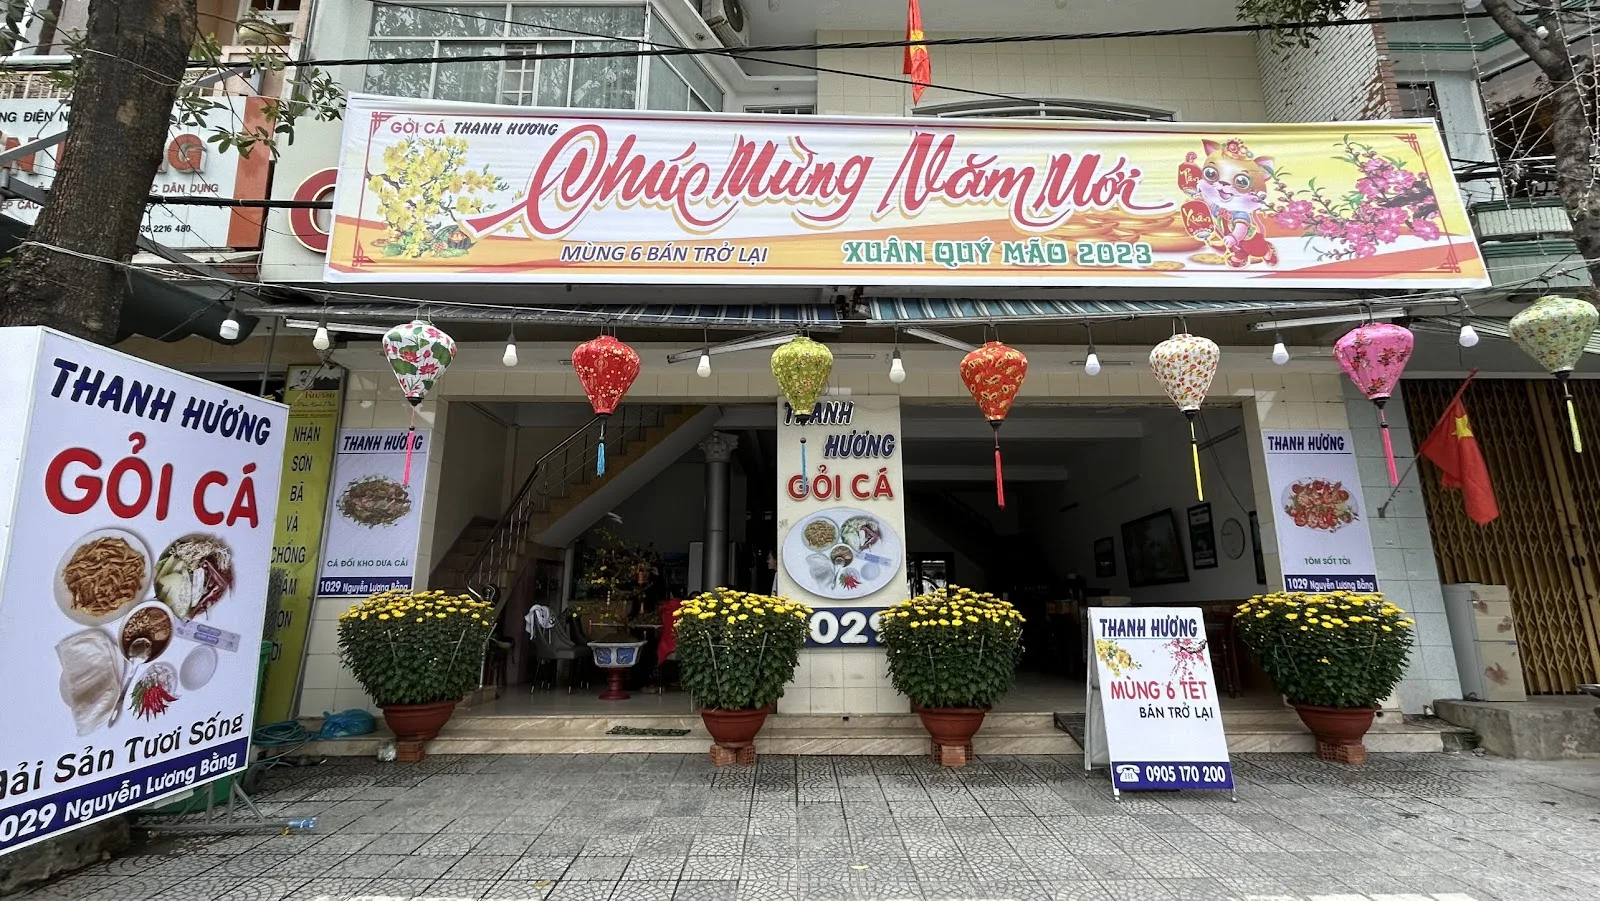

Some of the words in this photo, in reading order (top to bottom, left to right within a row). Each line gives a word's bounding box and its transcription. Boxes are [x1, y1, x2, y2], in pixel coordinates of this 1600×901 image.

[23, 109, 53, 124] ĐIỆN
[390, 118, 419, 134] GỎI
[424, 119, 446, 134] CÁ
[453, 121, 501, 135] THANH
[506, 122, 559, 136] HƯƠNG
[162, 181, 185, 193] DÂN
[189, 183, 219, 196] DỤNG
[466, 124, 739, 234] Chúc
[712, 135, 874, 222] Mừng
[876, 131, 1070, 227] Năm
[1031, 152, 1175, 212] Mới
[1182, 207, 1211, 227] Xuân
[153, 224, 172, 233] 2216
[175, 224, 191, 233] 480
[560, 243, 626, 261] MÙNG
[630, 246, 643, 261] 6
[647, 243, 688, 261] BÁN
[694, 242, 735, 262] TRỞ
[738, 247, 768, 266] LẠI
[843, 238, 924, 263] XUÂN
[932, 238, 993, 267] QUÝ
[1003, 239, 1067, 264] MÃO
[1078, 243, 1152, 264] 2023
[51, 357, 176, 423] THANH
[181, 397, 271, 446] HƯƠNG
[783, 401, 853, 425] TANH
[293, 421, 320, 445] NHẬN
[343, 435, 382, 451] THANH
[824, 429, 895, 457] HƯƠNG
[1267, 436, 1304, 451] THANH
[1308, 433, 1345, 451] HƯƠNG
[291, 453, 312, 472] SƠN
[45, 431, 174, 521] GỎI
[193, 462, 259, 528] CÁ
[787, 464, 841, 499] GỎI
[851, 466, 894, 499] CÁ
[290, 480, 304, 502] BÃ
[270, 539, 306, 564] CHỐNG
[327, 558, 339, 568] CÁ
[341, 557, 355, 567] ĐỐI
[357, 559, 374, 567] KHO
[376, 558, 392, 567] DƯA
[320, 580, 341, 593] 1029
[1287, 578, 1308, 590] 1029
[1336, 580, 1356, 592] Lương
[1357, 577, 1375, 592] Bằng
[1099, 618, 1146, 637] THANH
[1151, 614, 1198, 637] HƯƠNG
[1110, 676, 1160, 700] MÙNG
[1166, 681, 1176, 700] 6
[1179, 671, 1207, 700] TẾT
[1139, 703, 1165, 719] BÁN
[1167, 702, 1191, 719] TRỞ
[1194, 706, 1214, 722] LẠI
[54, 745, 115, 784] Sản
[124, 726, 182, 764] Tươi
[189, 711, 244, 746] Sống
[1145, 765, 1177, 783] 0905
[1179, 765, 1200, 783] 170
[1202, 765, 1226, 783] 200
[64, 779, 141, 822] Nguyễn
[146, 765, 196, 797] Lương
[200, 751, 237, 777] Bằng
